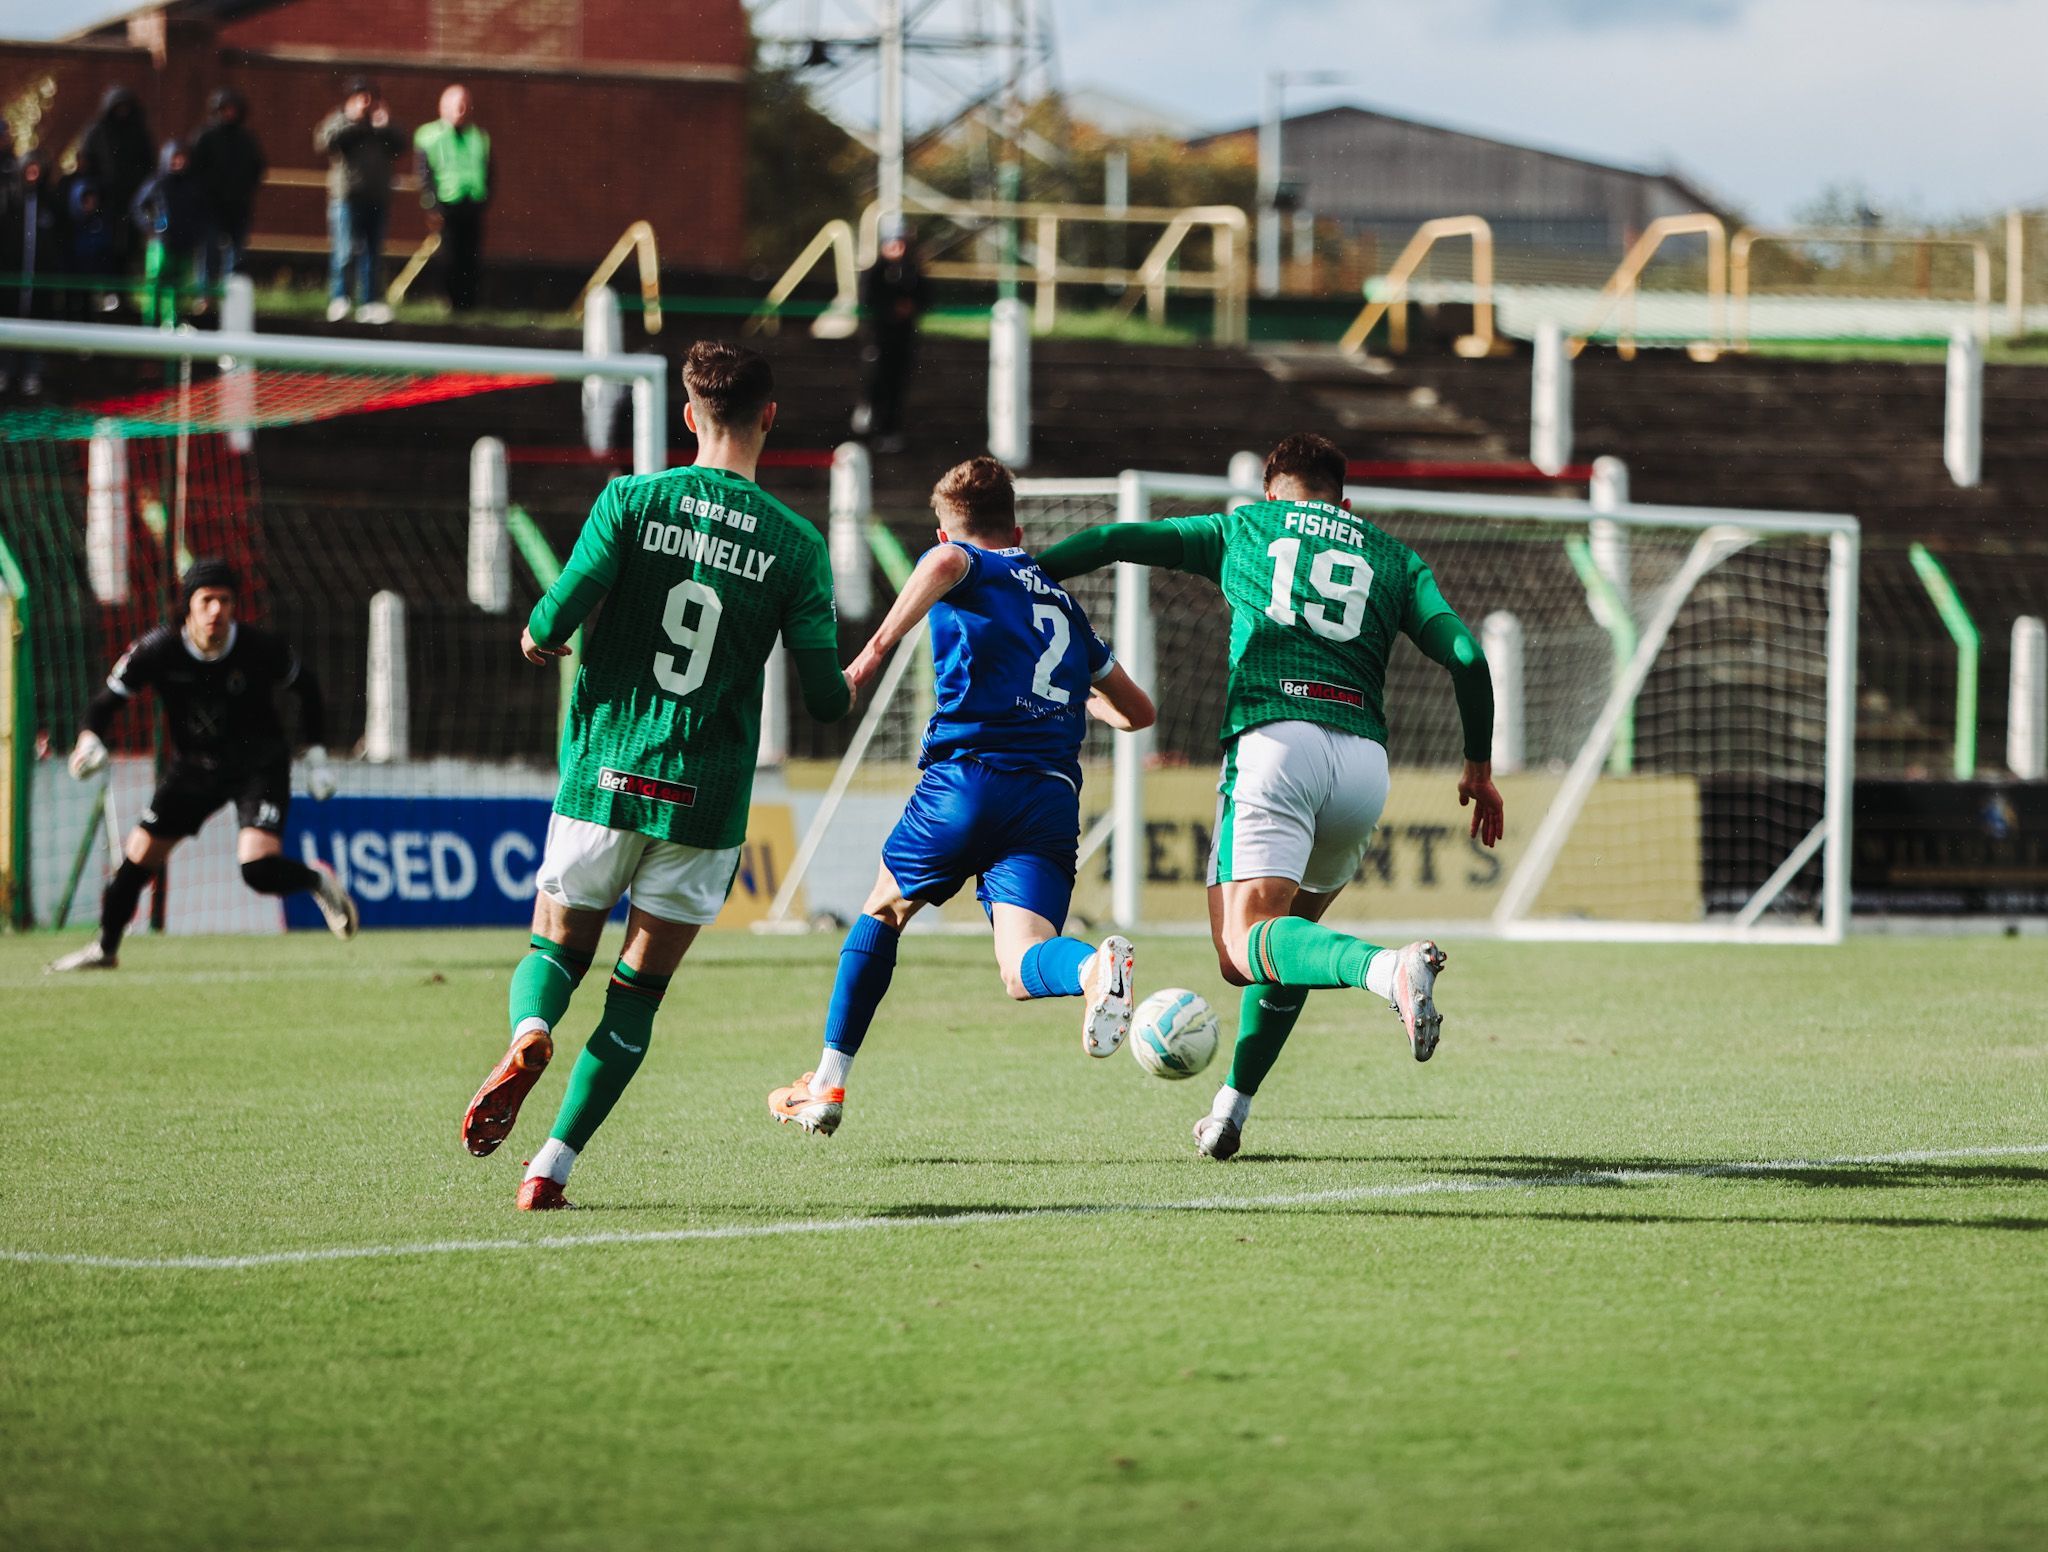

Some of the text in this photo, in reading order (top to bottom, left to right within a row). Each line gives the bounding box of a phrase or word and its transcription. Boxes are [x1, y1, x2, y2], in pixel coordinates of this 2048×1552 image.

[680, 495, 757, 533] BOX-IT
[1285, 511, 1365, 548] FISHER
[643, 520, 776, 582] DONNELLY
[1264, 537, 1375, 642] 19
[653, 578, 723, 696] 9
[1032, 603, 1071, 704] 2
[1283, 681, 1361, 706] BetMcLean
[301, 830, 478, 900] USED
